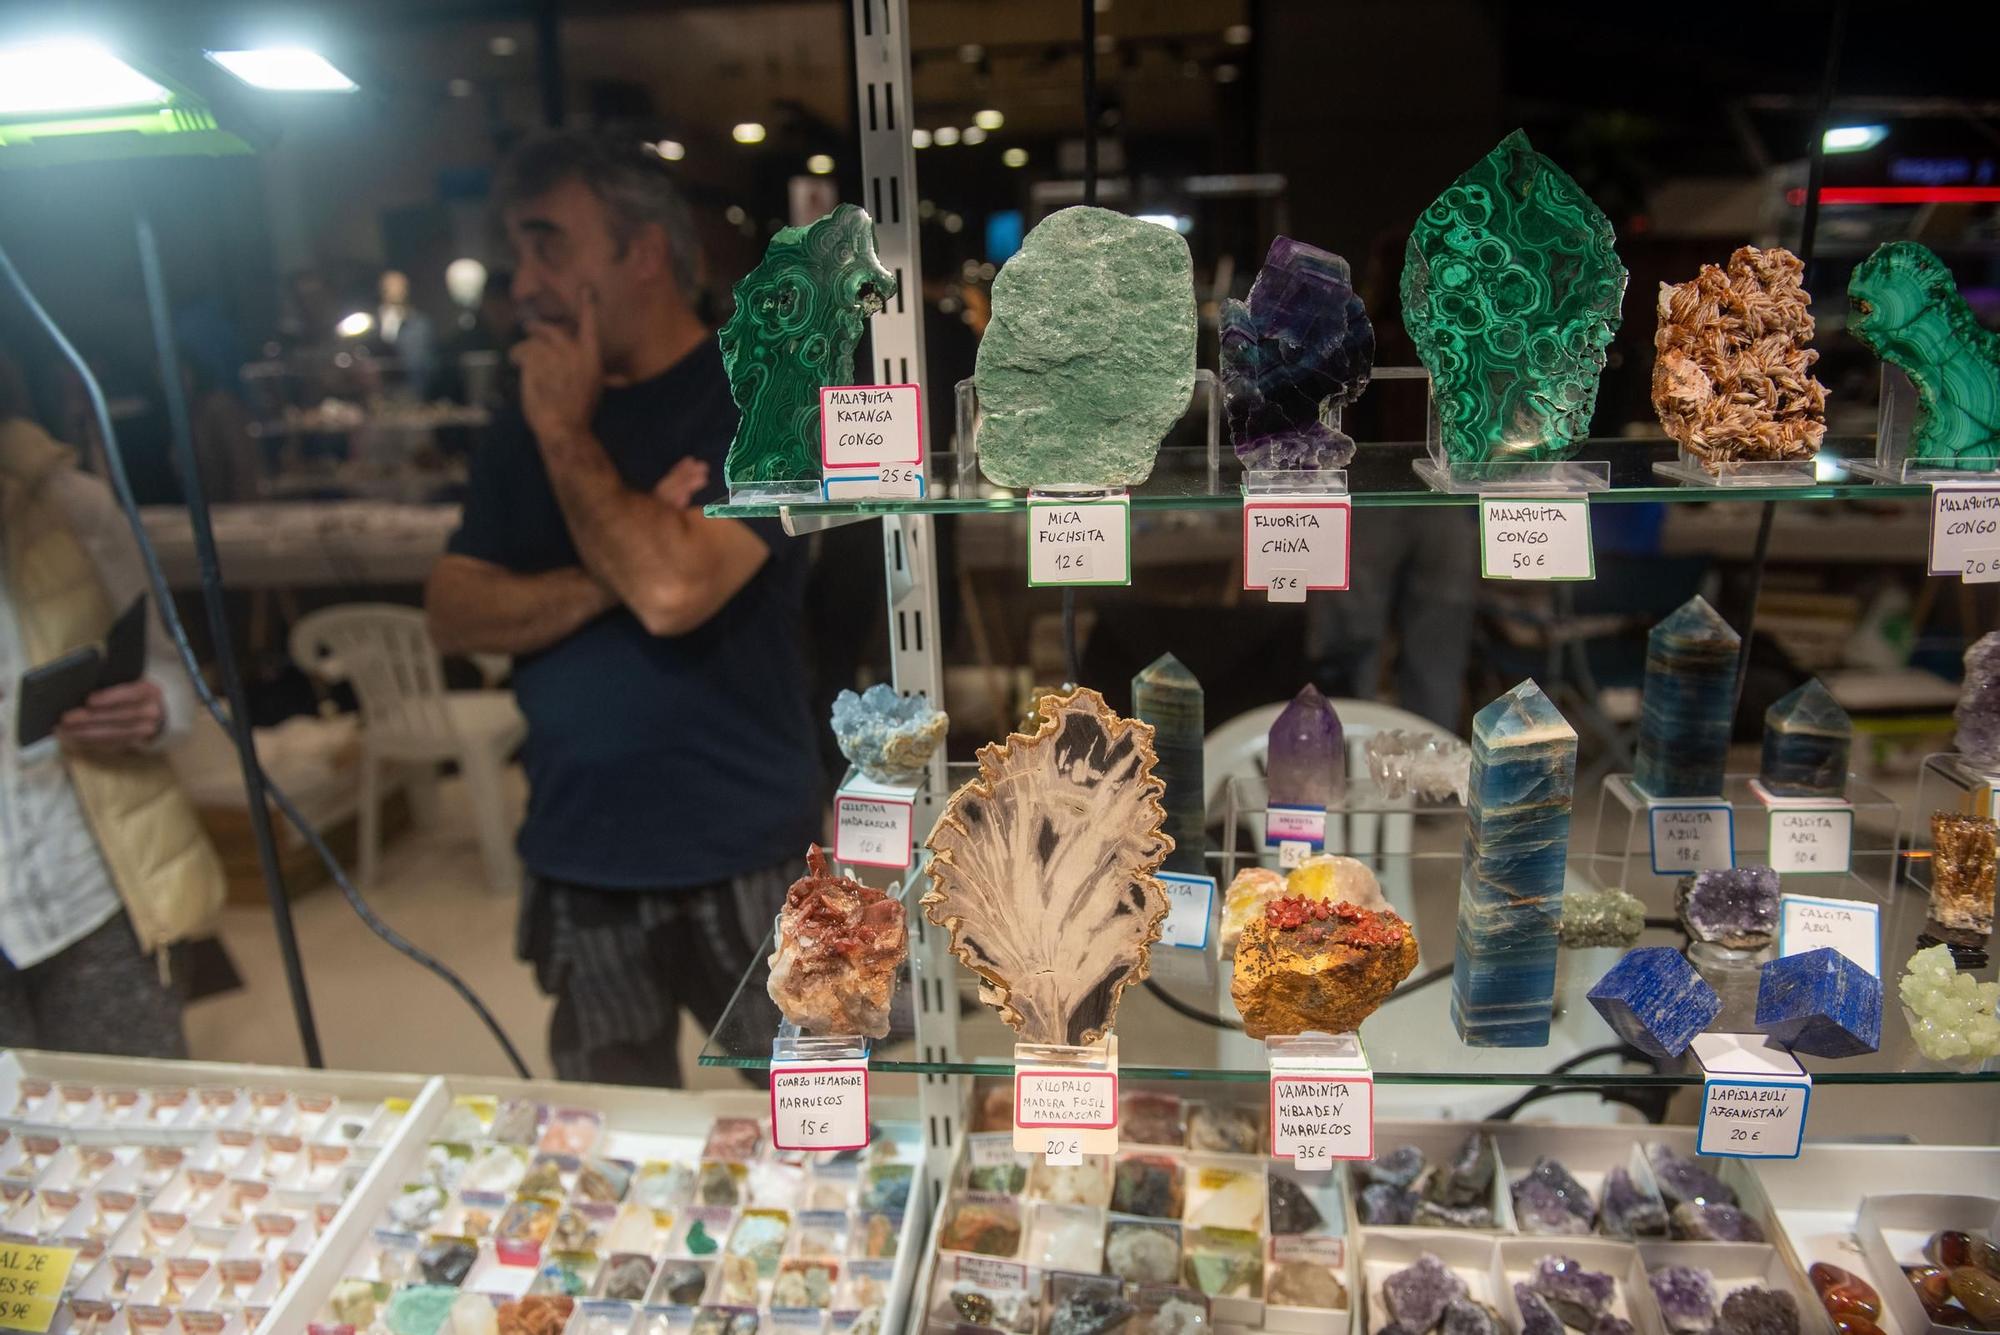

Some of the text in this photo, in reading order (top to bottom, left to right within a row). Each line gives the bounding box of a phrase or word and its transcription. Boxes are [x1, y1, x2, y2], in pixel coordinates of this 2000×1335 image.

[837, 409, 892, 422] KATANGA
[839, 432, 883, 446] CONGO
[1048, 511, 1081, 525] MICA
[1254, 513, 1319, 528] FLUORITA
[1489, 507, 1567, 521] MALAQUITA
[1947, 520, 1996, 535] CONGO
[1040, 529, 1104, 543] FUCHSITA
[1497, 530, 1548, 544] CONGO
[1261, 538, 1310, 553] CHINA
[1035, 1079, 1092, 1093] XILOPALO
[779, 1094, 844, 1110] MARRUECOS
[1023, 1097, 1065, 1109] MADERA
[1034, 1109, 1101, 1120] MADAGASCAR
[1280, 1123, 1352, 1137] MARRUECOS
